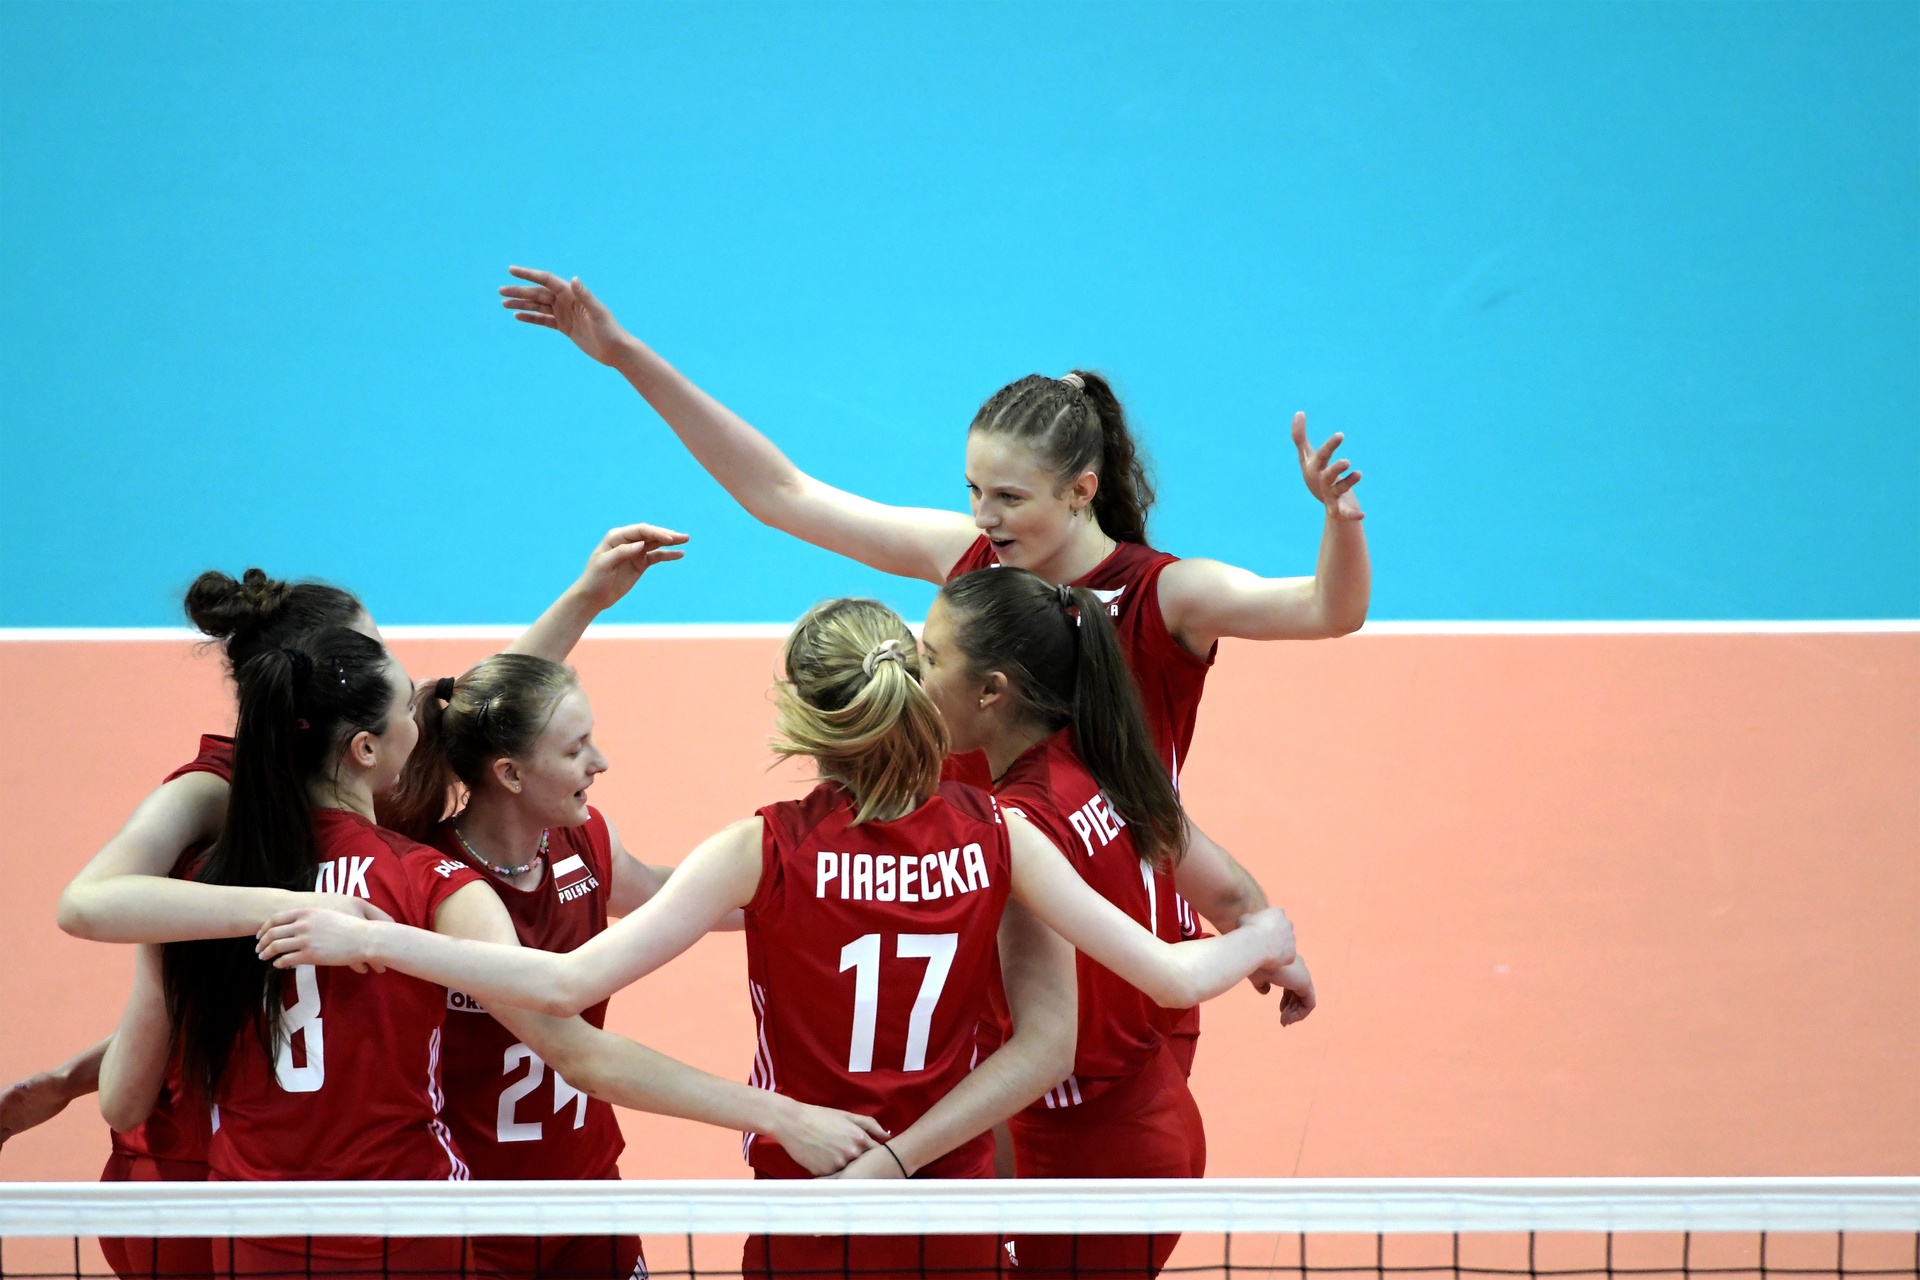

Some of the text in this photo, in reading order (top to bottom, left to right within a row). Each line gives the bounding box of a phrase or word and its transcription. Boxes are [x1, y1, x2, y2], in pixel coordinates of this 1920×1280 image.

[434, 859, 470, 878] plu
[816, 843, 990, 902] PIASECKA
[558, 876, 600, 904] POLSKA
[450, 992, 484, 1010] OR
[839, 933, 959, 1072] 17
